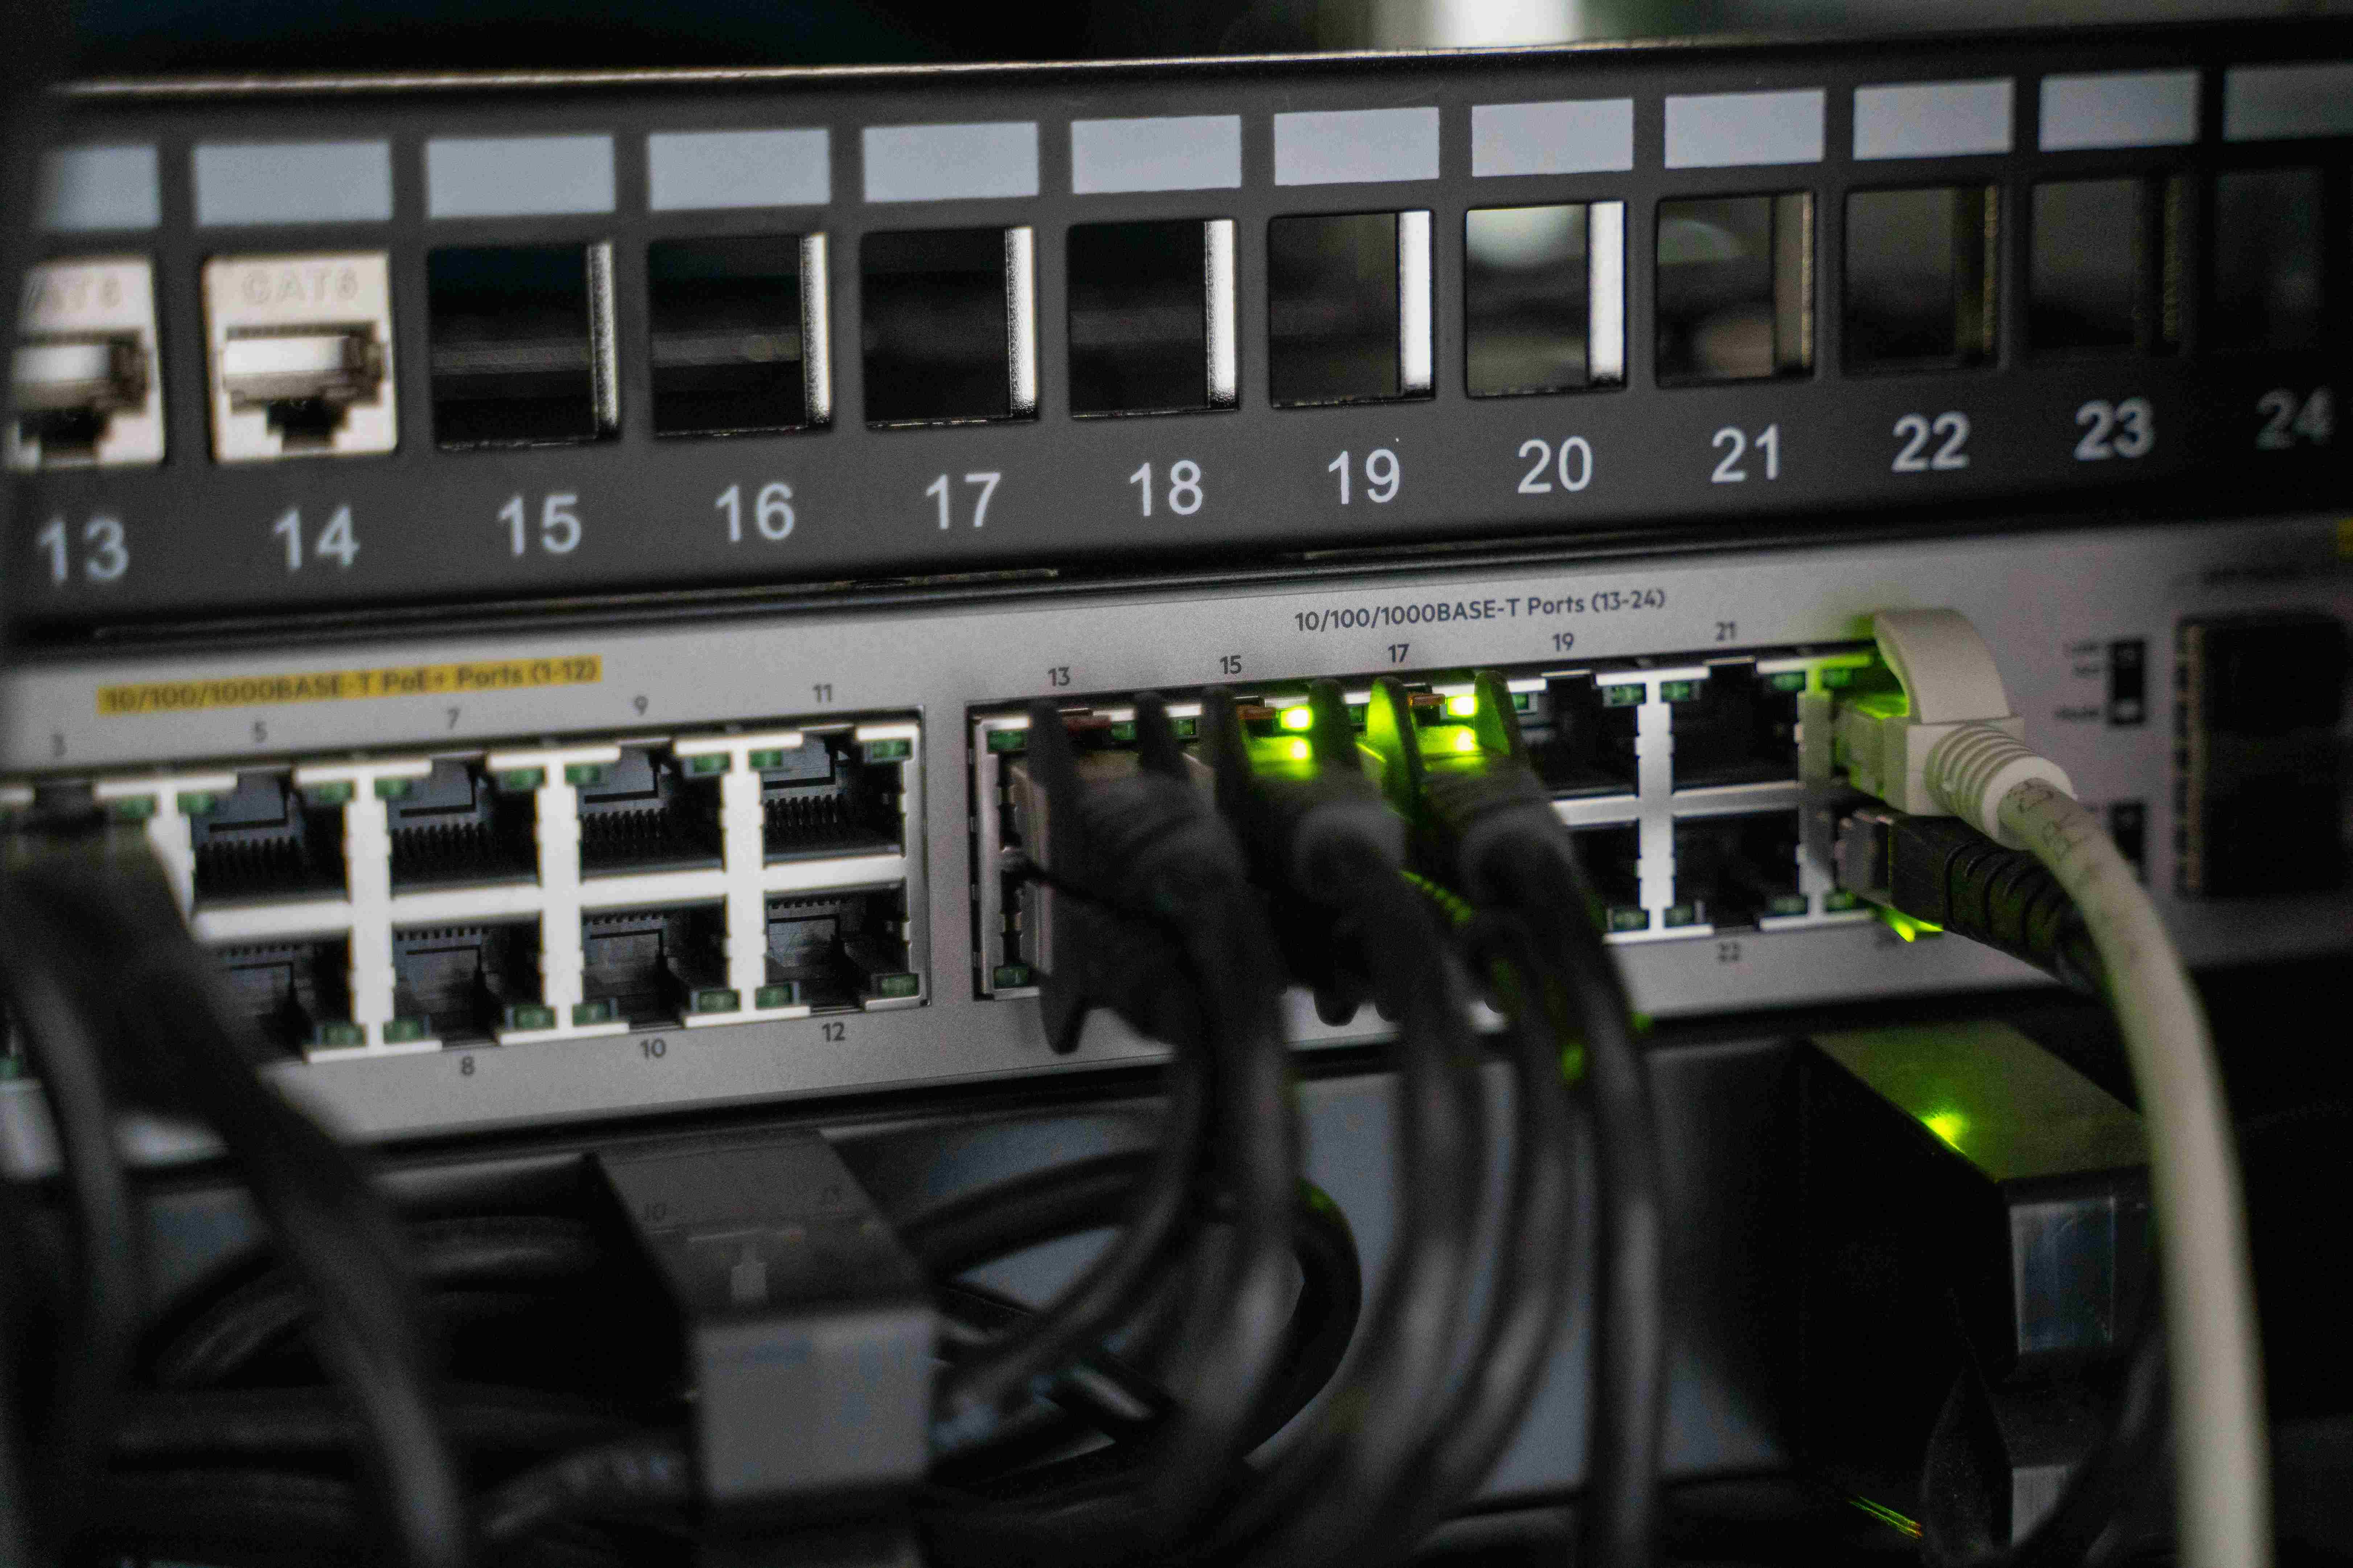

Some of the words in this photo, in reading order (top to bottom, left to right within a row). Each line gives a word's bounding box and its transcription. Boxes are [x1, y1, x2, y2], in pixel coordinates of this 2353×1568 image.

[2074, 400, 2152, 461] 23
[2257, 389, 2332, 450] 24
[1711, 425, 1780, 483] 21
[1891, 413, 1969, 472] 22
[1328, 448, 1400, 505] 19
[1517, 436, 1593, 494] 20
[926, 471, 1001, 530] 17
[1130, 459, 1204, 517] 18
[499, 494, 581, 555] 15
[716, 482, 795, 542] 16
[41, 517, 129, 581] 13
[275, 506, 359, 569] 14
[1295, 597, 1521, 632] 10/100/1000BASE-T
[1528, 596, 1585, 616] Ports
[1591, 588, 1665, 614] (13-24)
[1552, 632, 1575, 652] 19
[1716, 622, 1736, 641] 21
[1220, 654, 1243, 675] 15
[1388, 643, 1410, 664] 17
[457, 663, 522, 688] Ports
[531, 657, 597, 683] (1-12)
[1048, 666, 1071, 687] 13
[633, 695, 648, 716] 9
[813, 683, 833, 702] 11
[253, 721, 267, 743] 5
[447, 707, 461, 730] 7
[640, 1038, 667, 1059] 10
[822, 1022, 845, 1042] 12
[460, 1056, 475, 1077] 8
